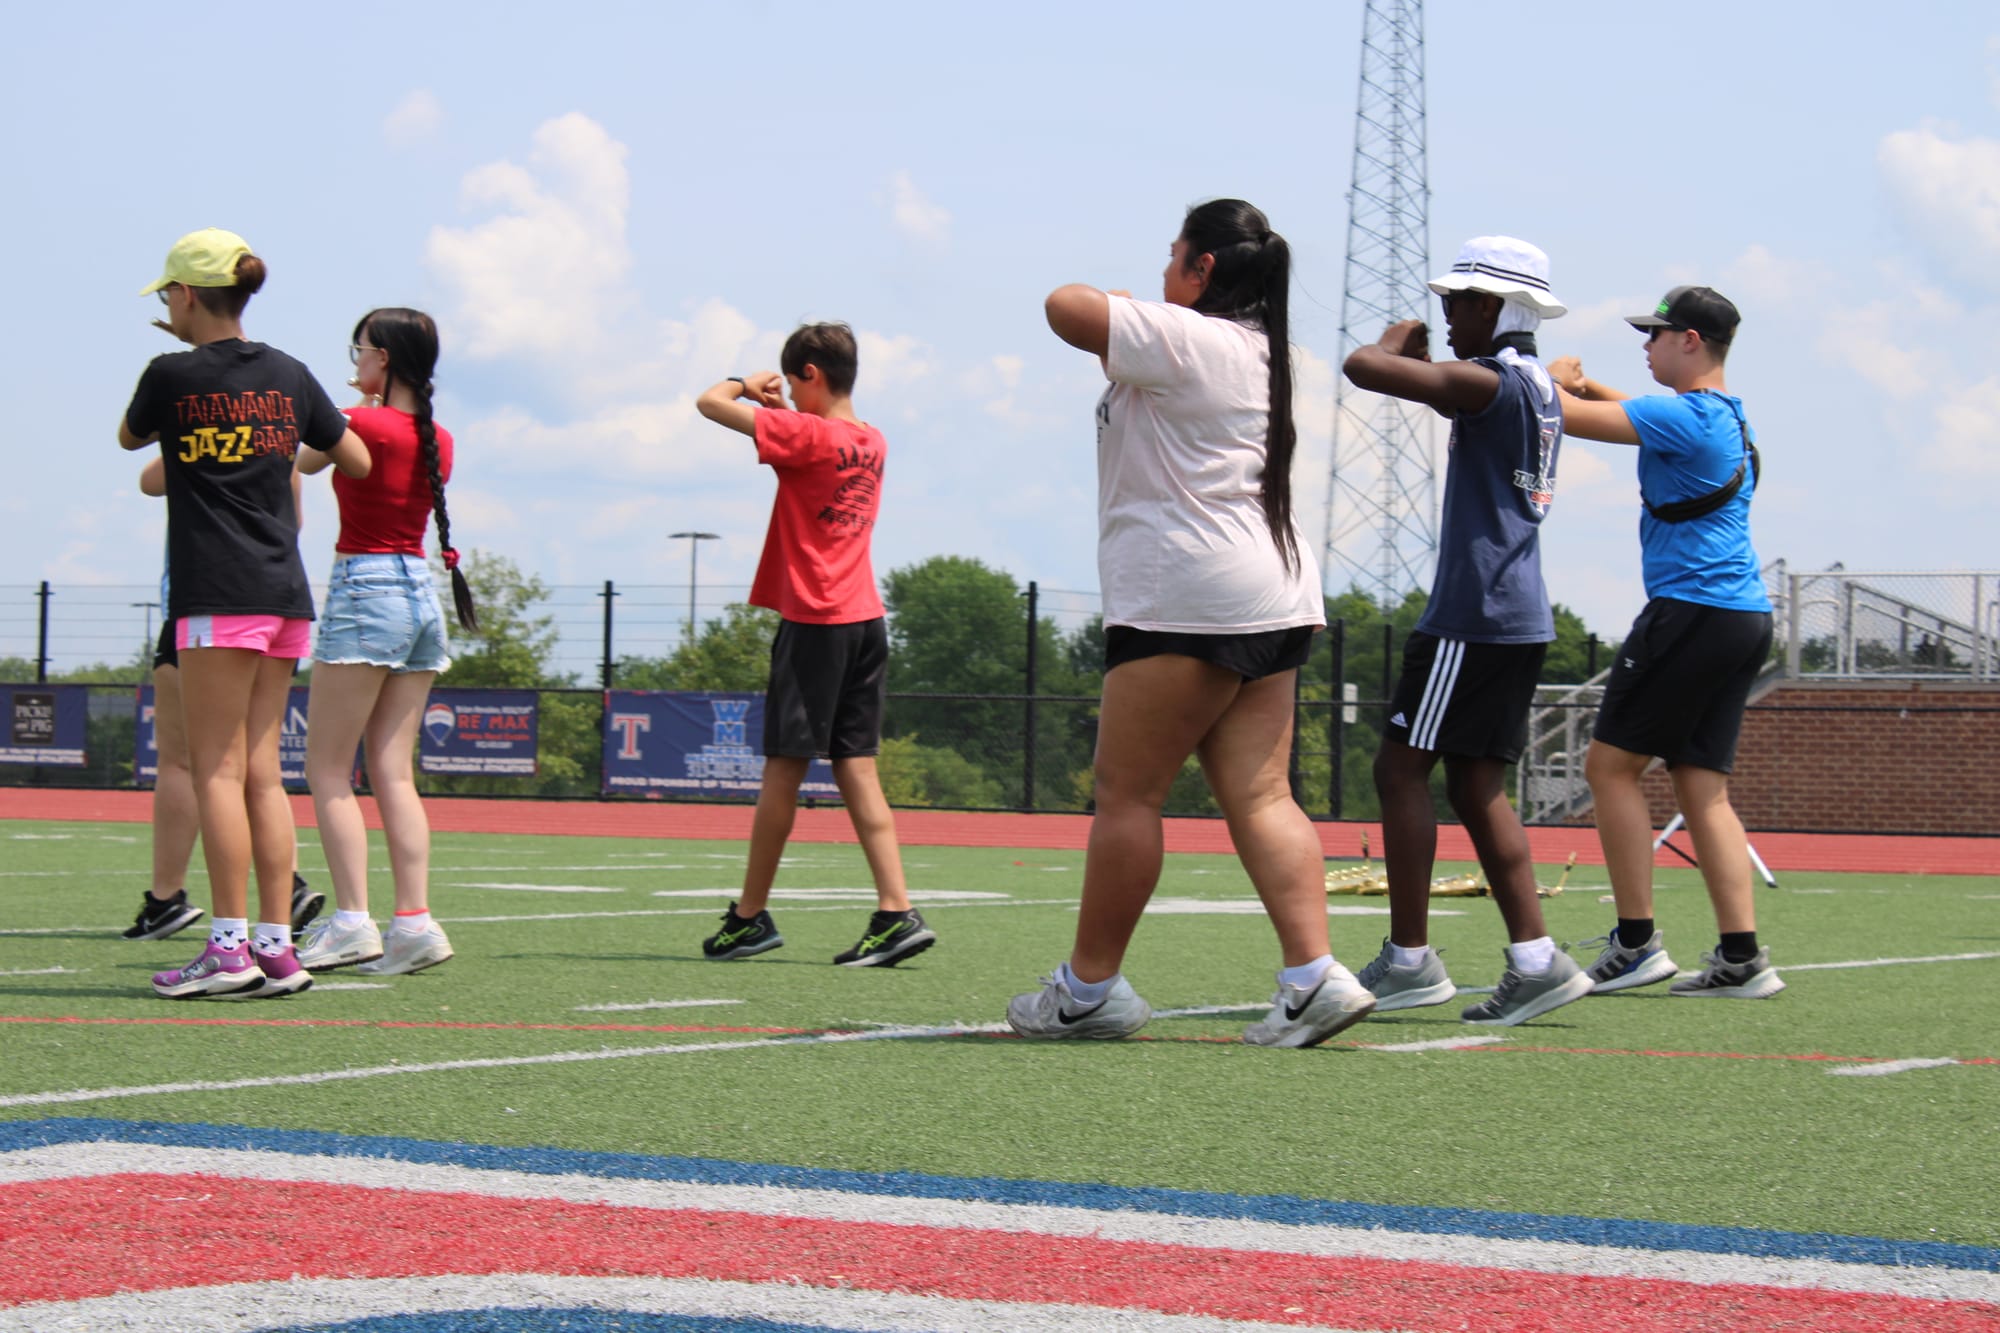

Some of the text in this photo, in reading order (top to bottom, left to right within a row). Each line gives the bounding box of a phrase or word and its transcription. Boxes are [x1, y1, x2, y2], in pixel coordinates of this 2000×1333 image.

[175, 390, 298, 427] TALAWANDA
[178, 425, 255, 463] JAZZ
[610, 712, 651, 760] T
